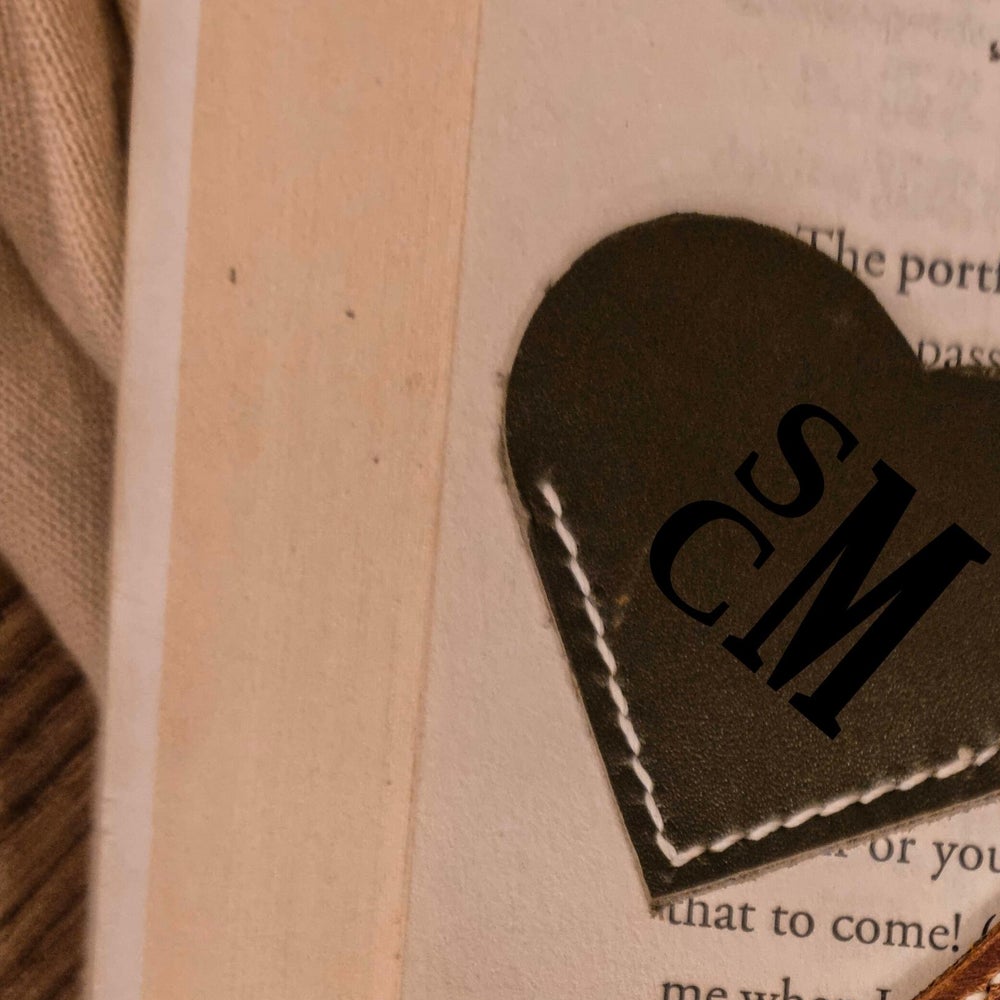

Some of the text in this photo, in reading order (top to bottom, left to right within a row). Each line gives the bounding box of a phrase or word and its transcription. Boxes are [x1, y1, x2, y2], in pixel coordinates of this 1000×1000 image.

[868, 836, 917, 865] or
[667, 896, 756, 933] that
[772, 906, 815, 939] to
[832, 912, 962, 953] come!
